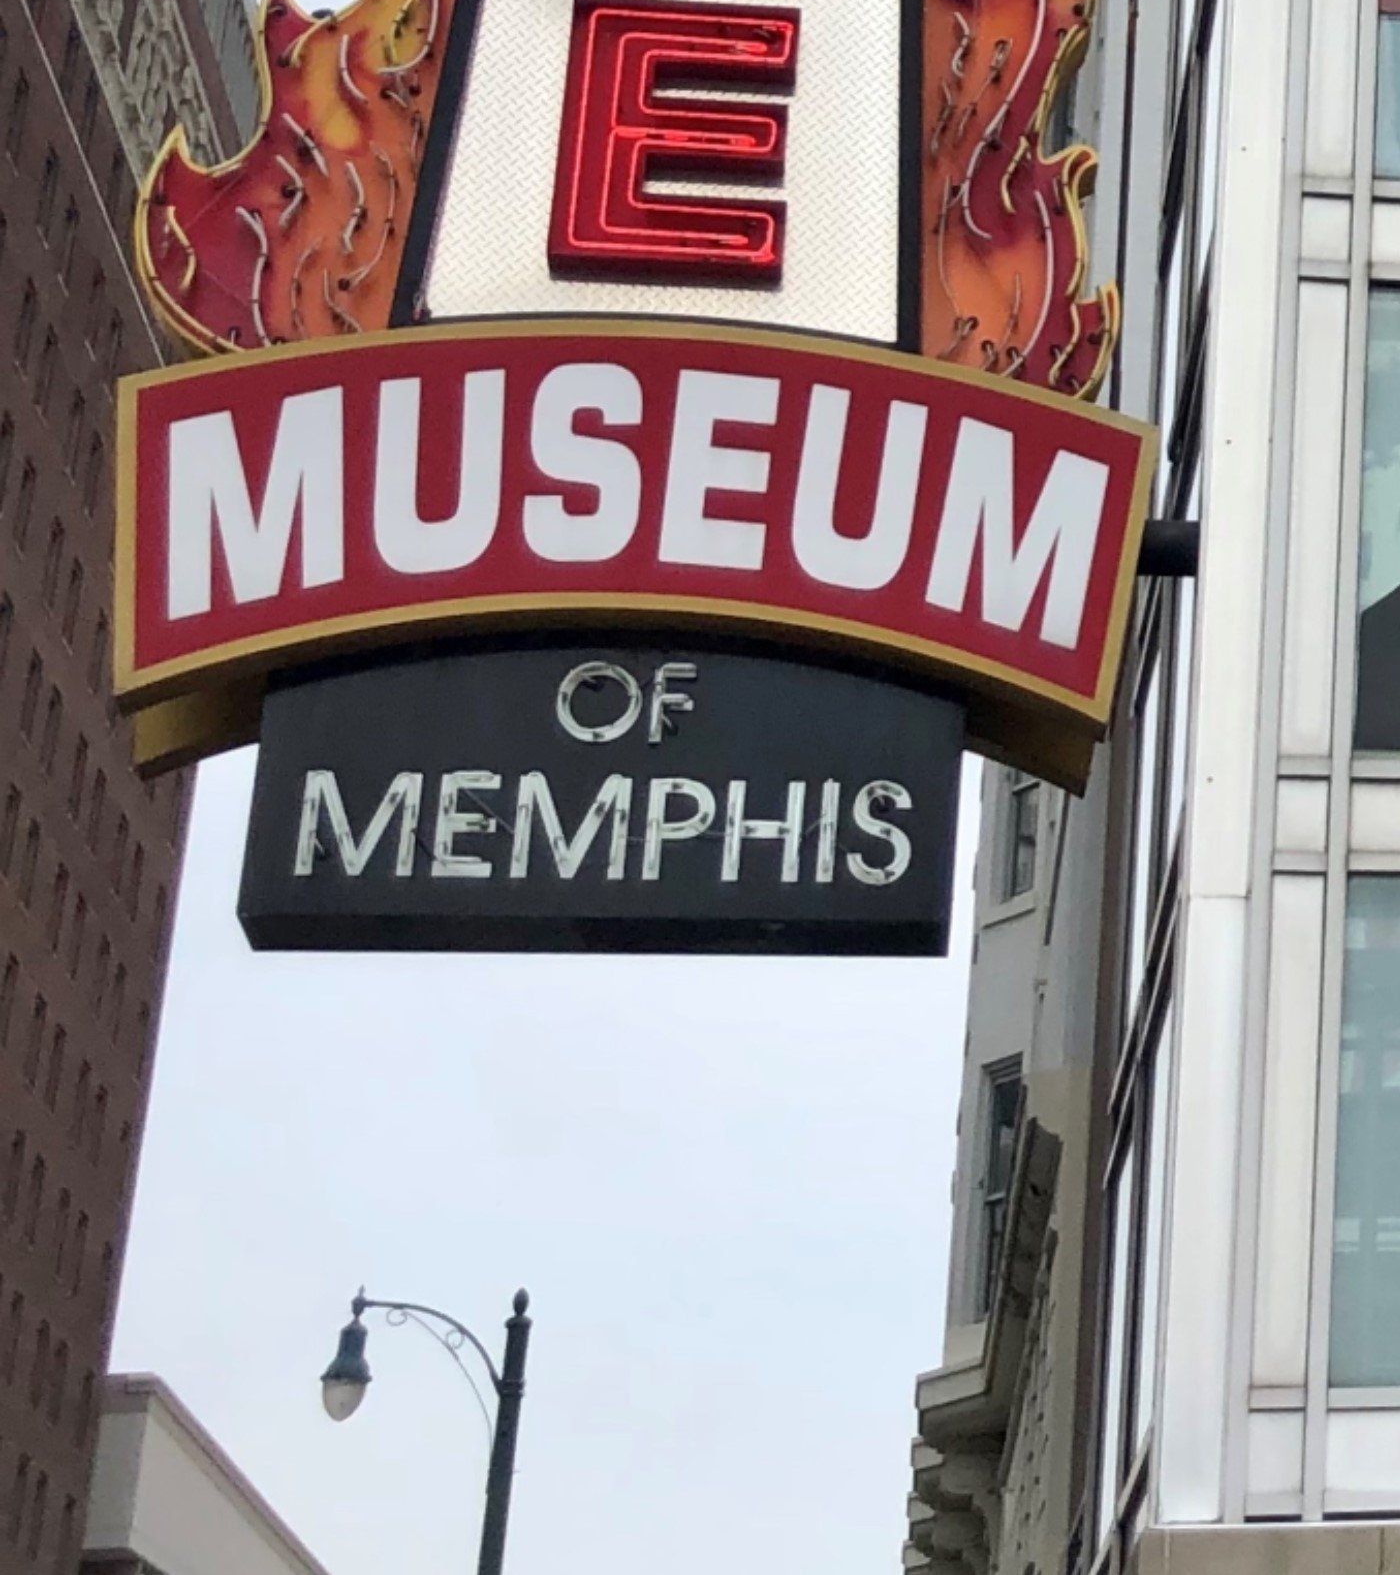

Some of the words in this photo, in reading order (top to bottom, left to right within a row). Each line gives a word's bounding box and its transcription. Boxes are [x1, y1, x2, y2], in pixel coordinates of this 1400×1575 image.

[166, 362, 1111, 651] MUSEUM
[555, 660, 698, 744] OF
[294, 769, 913, 887] MEMPHIS
